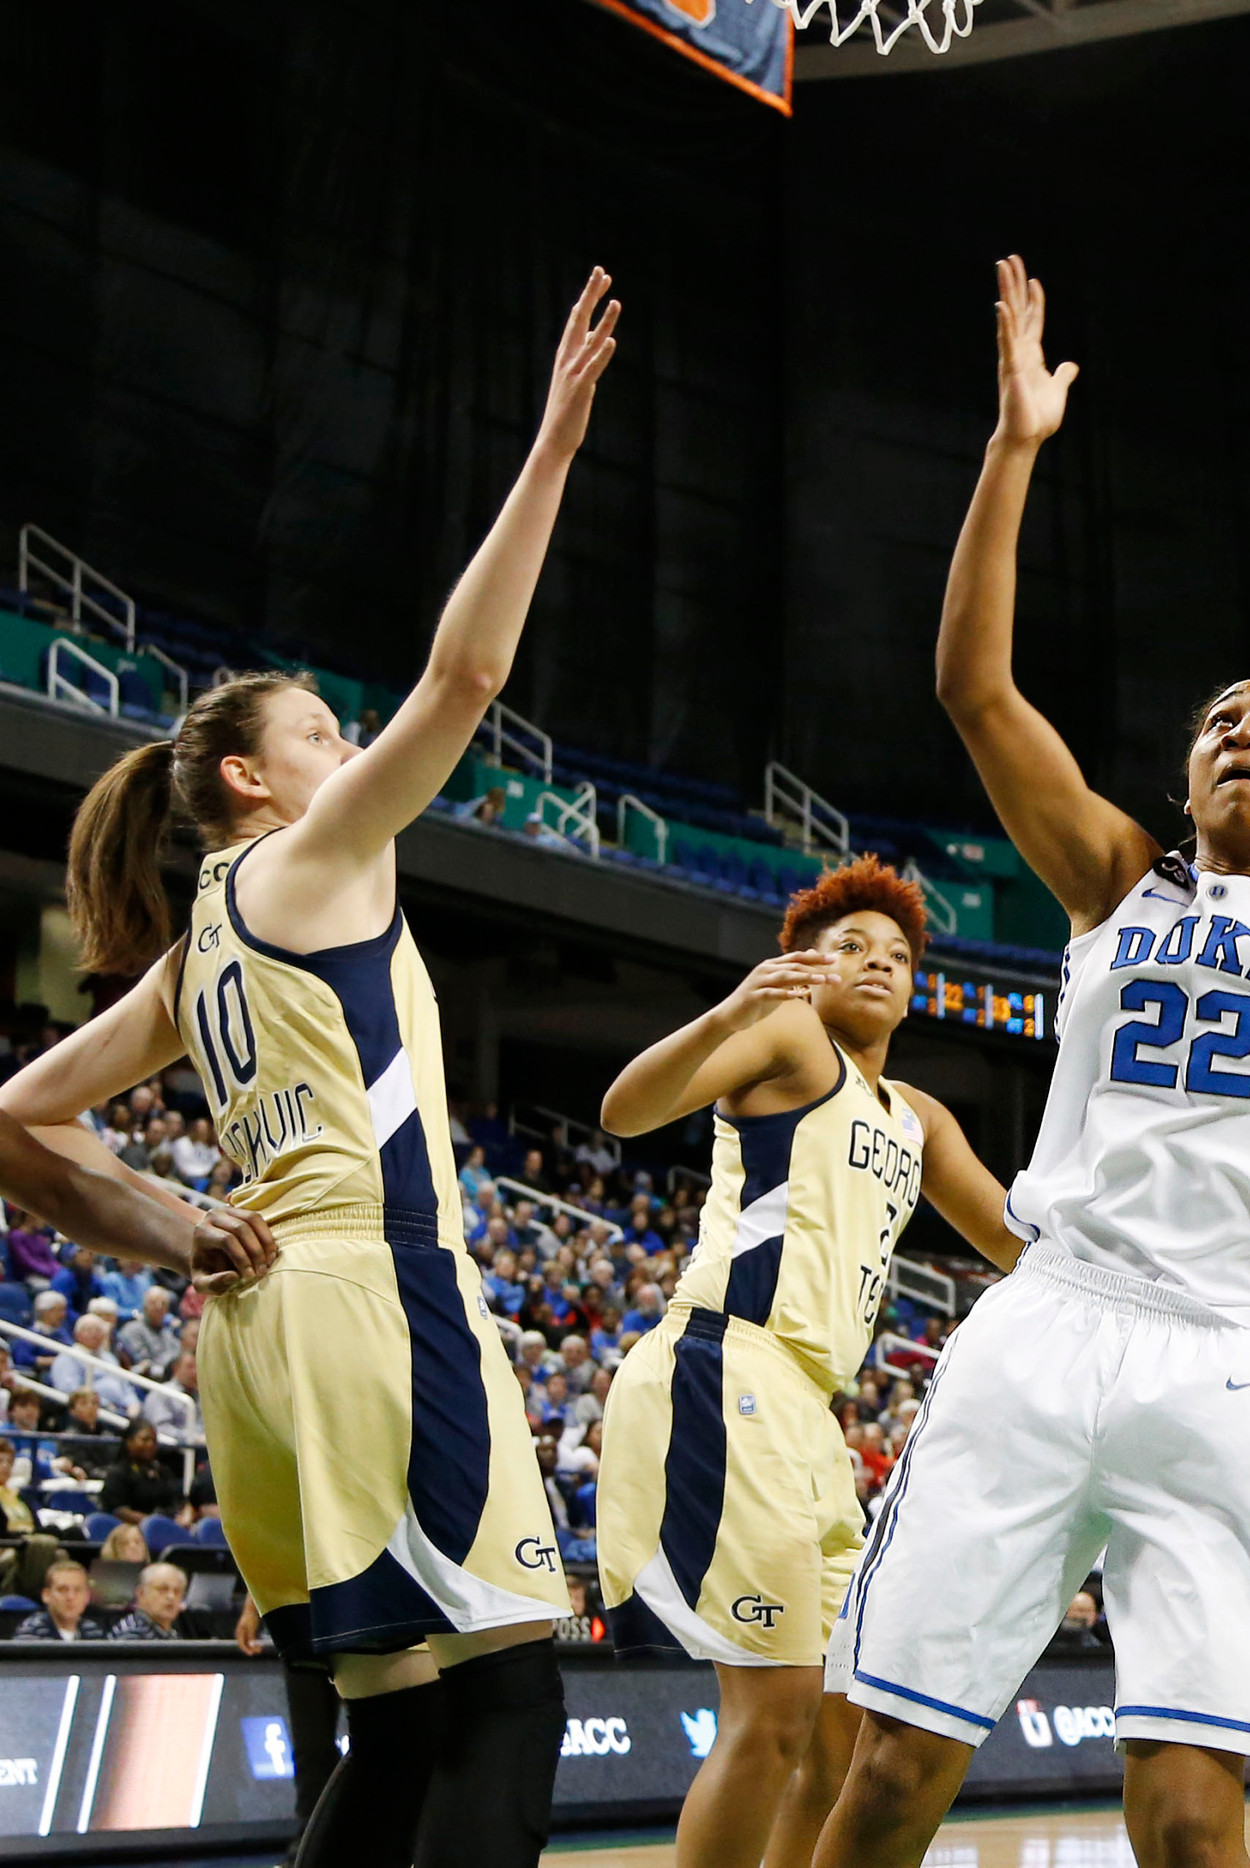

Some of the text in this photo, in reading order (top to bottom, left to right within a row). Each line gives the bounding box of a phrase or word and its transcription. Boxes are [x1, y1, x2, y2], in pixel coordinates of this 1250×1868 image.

[198, 923, 223, 953] GT
[197, 960, 257, 1108] 10
[515, 1536, 556, 1573] GT
[731, 1595, 784, 1628] GT
